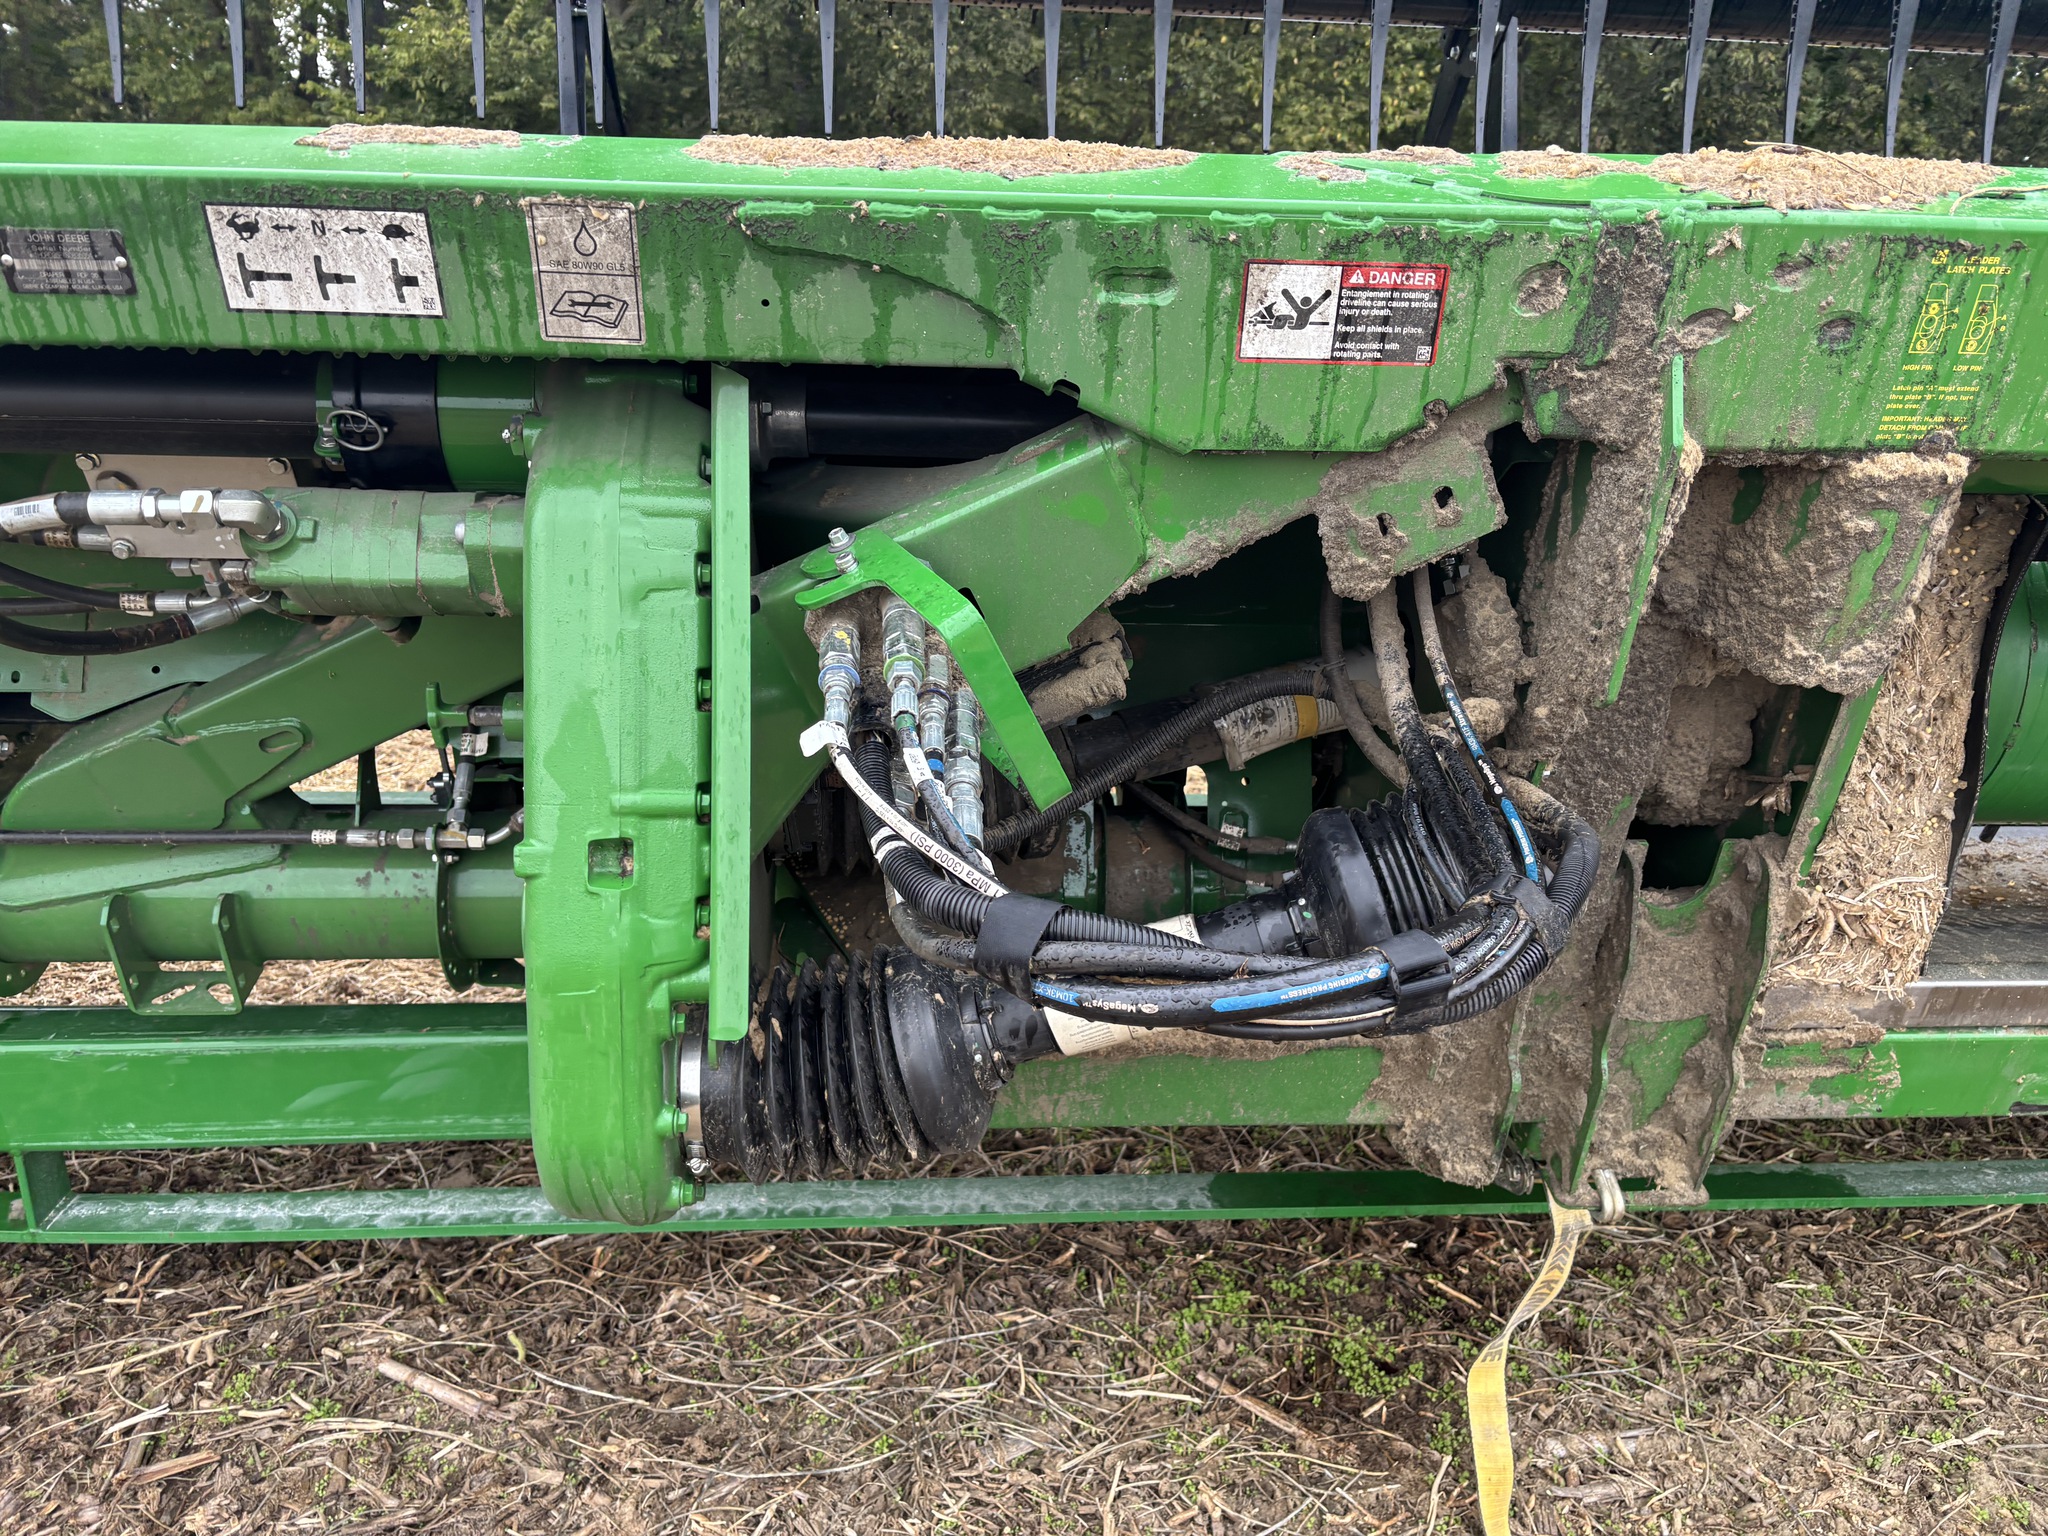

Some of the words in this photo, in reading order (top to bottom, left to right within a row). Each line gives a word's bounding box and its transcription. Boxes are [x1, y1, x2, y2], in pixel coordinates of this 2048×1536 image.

[311, 220, 326, 236] N
[27, 234, 54, 242] JOHN
[58, 234, 90, 243] DEERE
[549, 260, 570, 269] SAE
[572, 261, 604, 271] 80W90
[606, 262, 626, 272] GL5
[1947, 266, 1975, 274] LATCH
[1978, 266, 2012, 274] PLATES
[1368, 271, 1436, 286] DANGER
[1342, 289, 1392, 298] Entanglement
[1402, 292, 1430, 300] rotating
[1411, 300, 1438, 308] serious
[1339, 307, 1360, 316] injury
[1337, 324, 1355, 333] Keep
[1367, 325, 1393, 333] shields
[1333, 351, 1360, 359] rotating
[910, 831, 934, 854] PSI)
[934, 850, 965, 875] (3000
[966, 870, 991, 893] MPa
[1328, 974, 1364, 990] POWERING
[1280, 983, 1328, 1000] PROGRESS™
[1082, 999, 1136, 1013] MegaSys™
